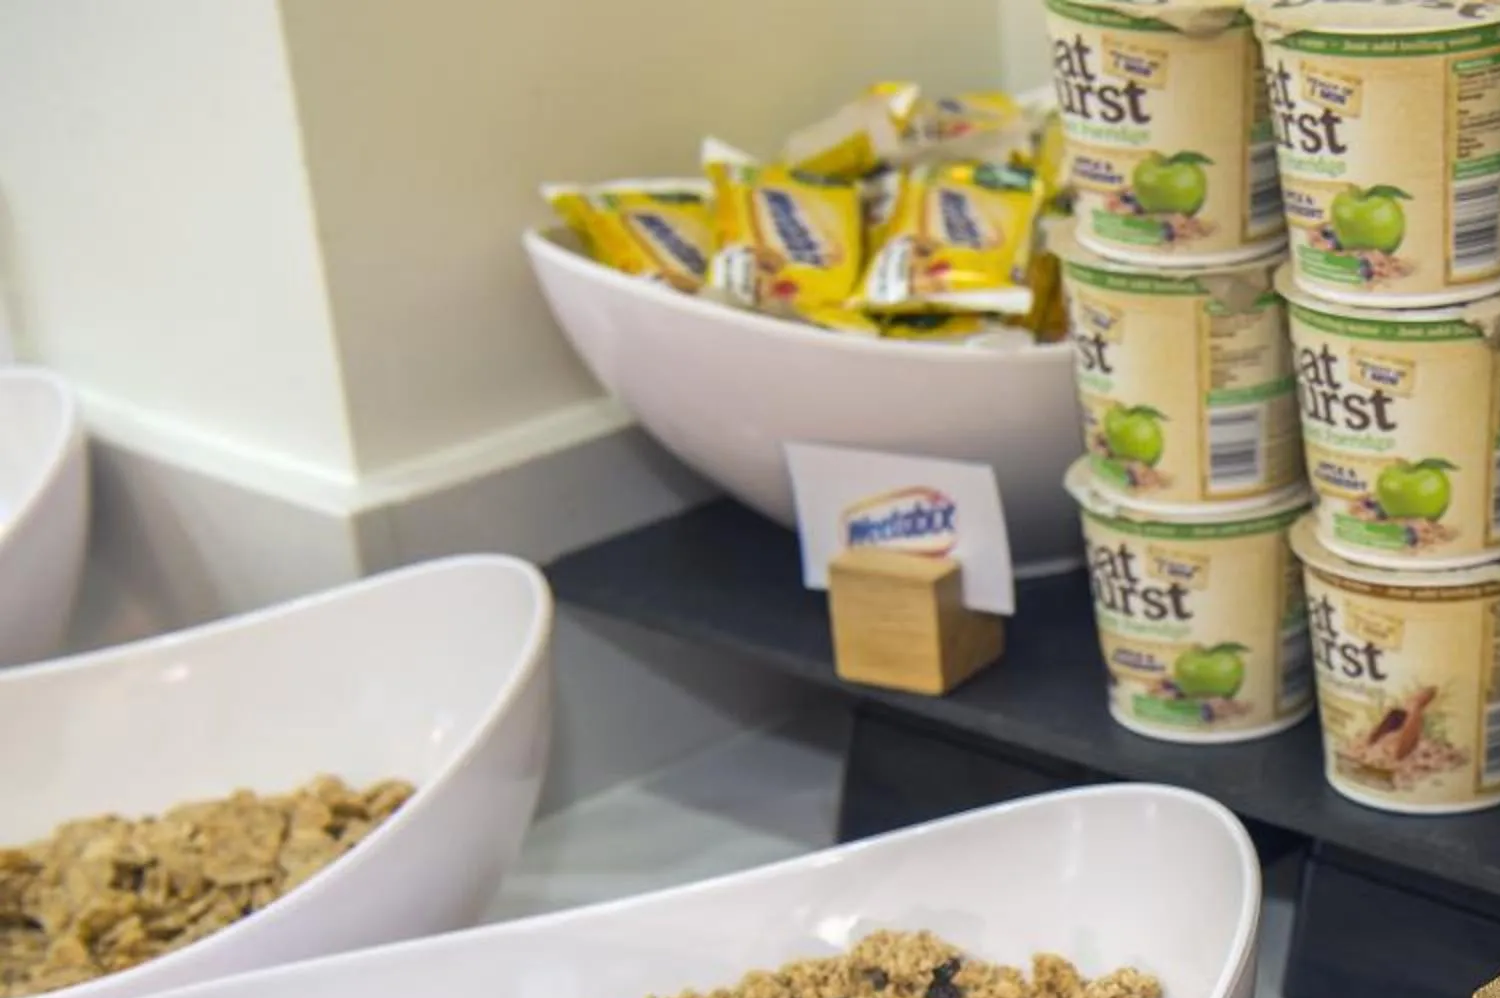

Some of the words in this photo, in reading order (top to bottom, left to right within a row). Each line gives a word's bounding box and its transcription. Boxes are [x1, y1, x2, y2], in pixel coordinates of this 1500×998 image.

[1054, 33, 1096, 81] at
[1300, 343, 1342, 390] at
[1094, 542, 1139, 586] at
